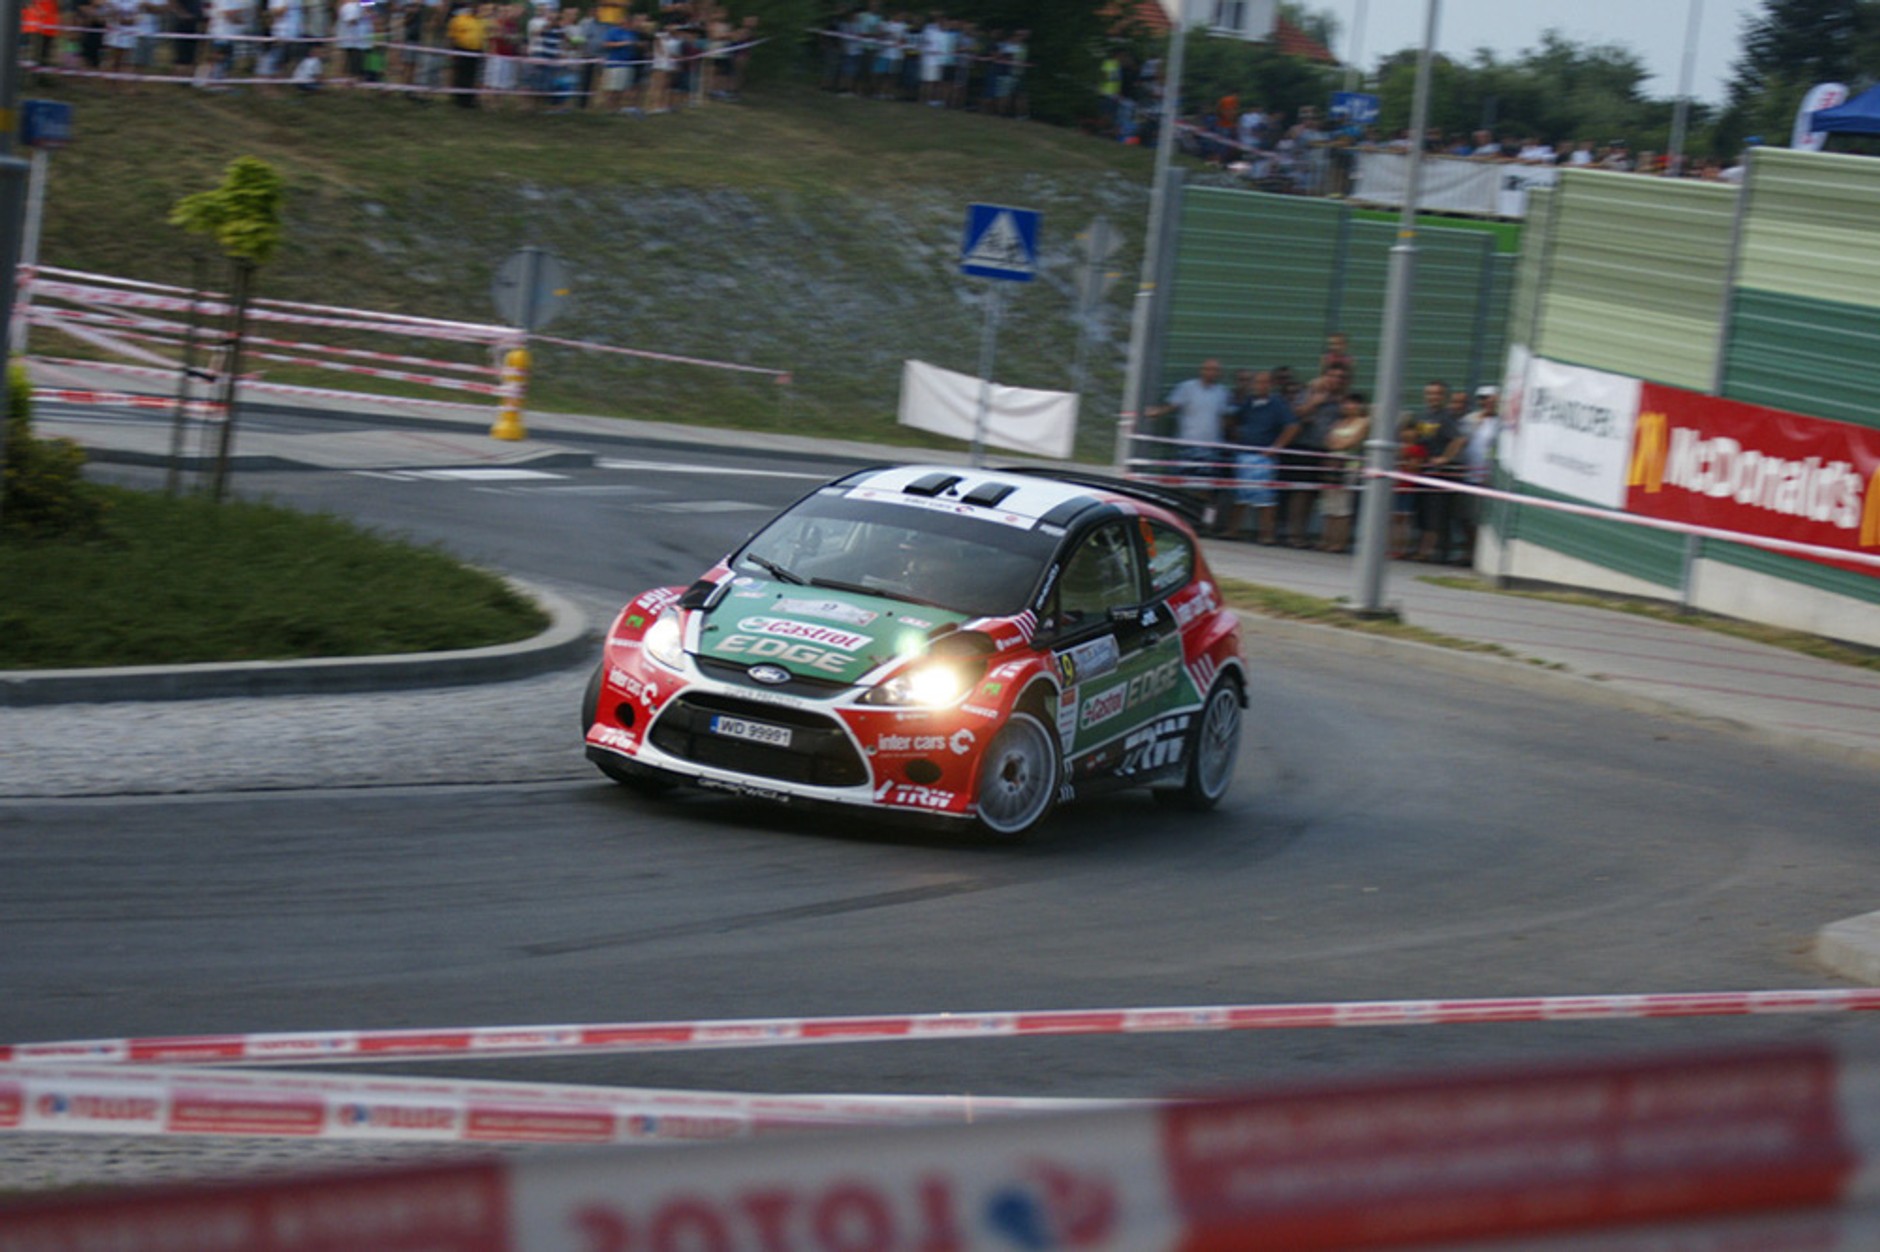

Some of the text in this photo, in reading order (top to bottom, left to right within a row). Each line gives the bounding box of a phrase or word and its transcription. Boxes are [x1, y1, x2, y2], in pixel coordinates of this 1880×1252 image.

[1664, 426, 1864, 529] McDonald's
[766, 619, 860, 648] Castrol
[715, 633, 857, 673] EDGE
[721, 719, 745, 735] WD
[878, 733, 946, 750] inter cars
[896, 784, 955, 808] TRW
